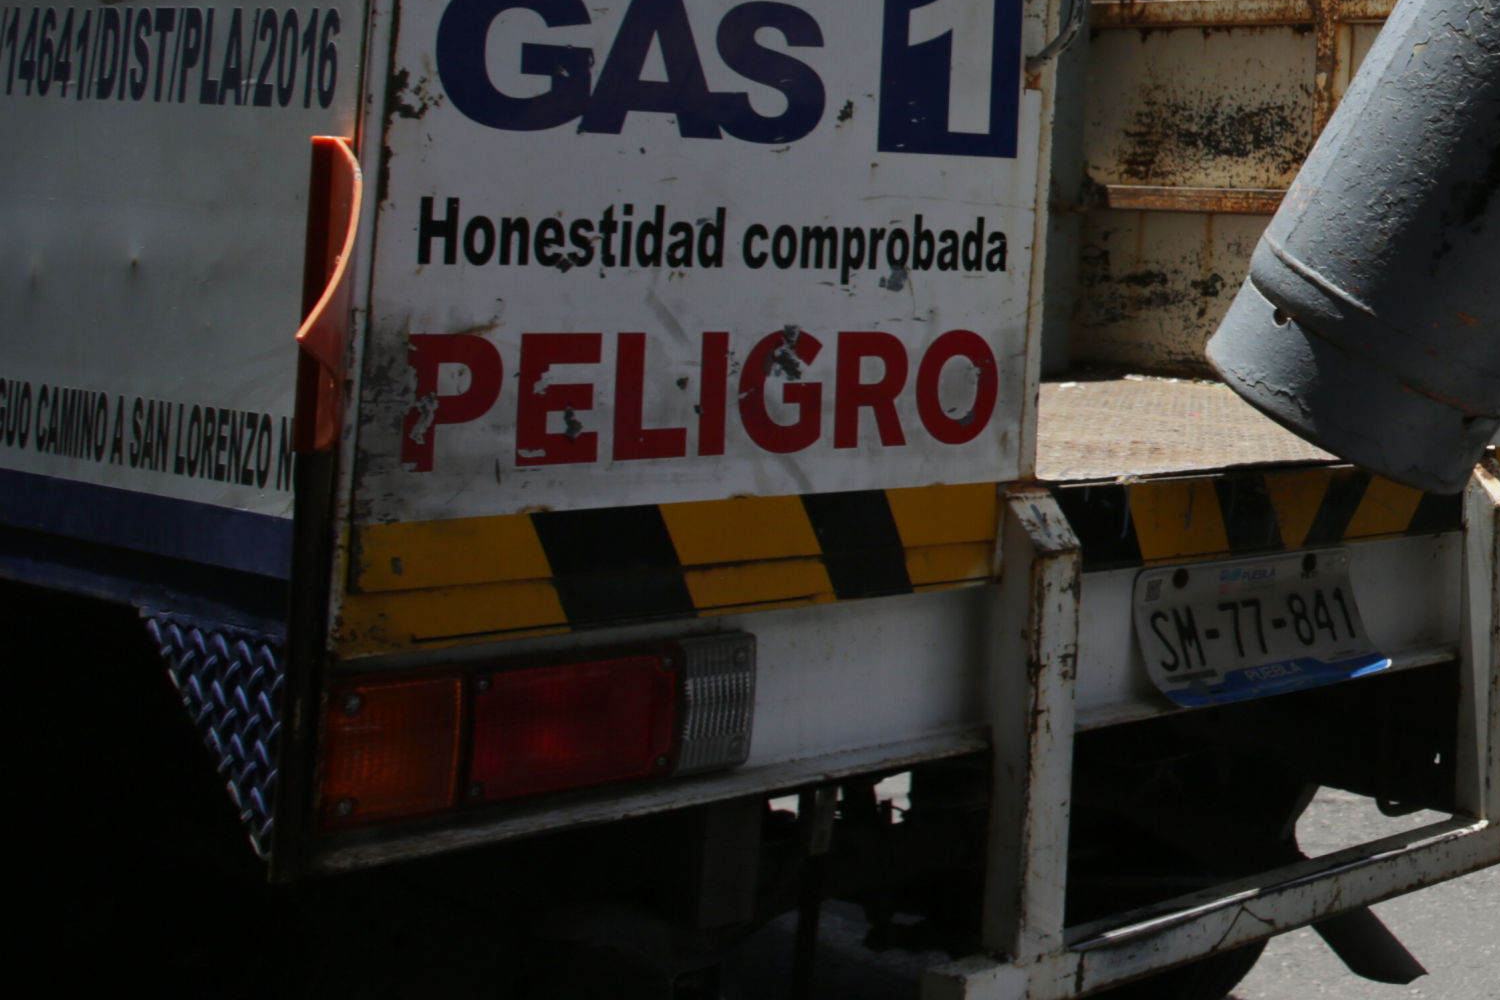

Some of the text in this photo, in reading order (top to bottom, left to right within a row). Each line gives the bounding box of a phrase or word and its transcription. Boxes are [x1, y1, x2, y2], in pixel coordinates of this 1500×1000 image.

[417, 196, 1008, 285] Honestidad comprobada
[36, 384, 108, 462] CAMINO
[110, 395, 124, 465] A
[130, 398, 172, 472] SAN
[174, 402, 273, 489] LORENZO
[400, 328, 999, 473] PELIGRO
[1150, 587, 1356, 673] SM-77-841
[1244, 661, 1304, 682] PUEBLA
